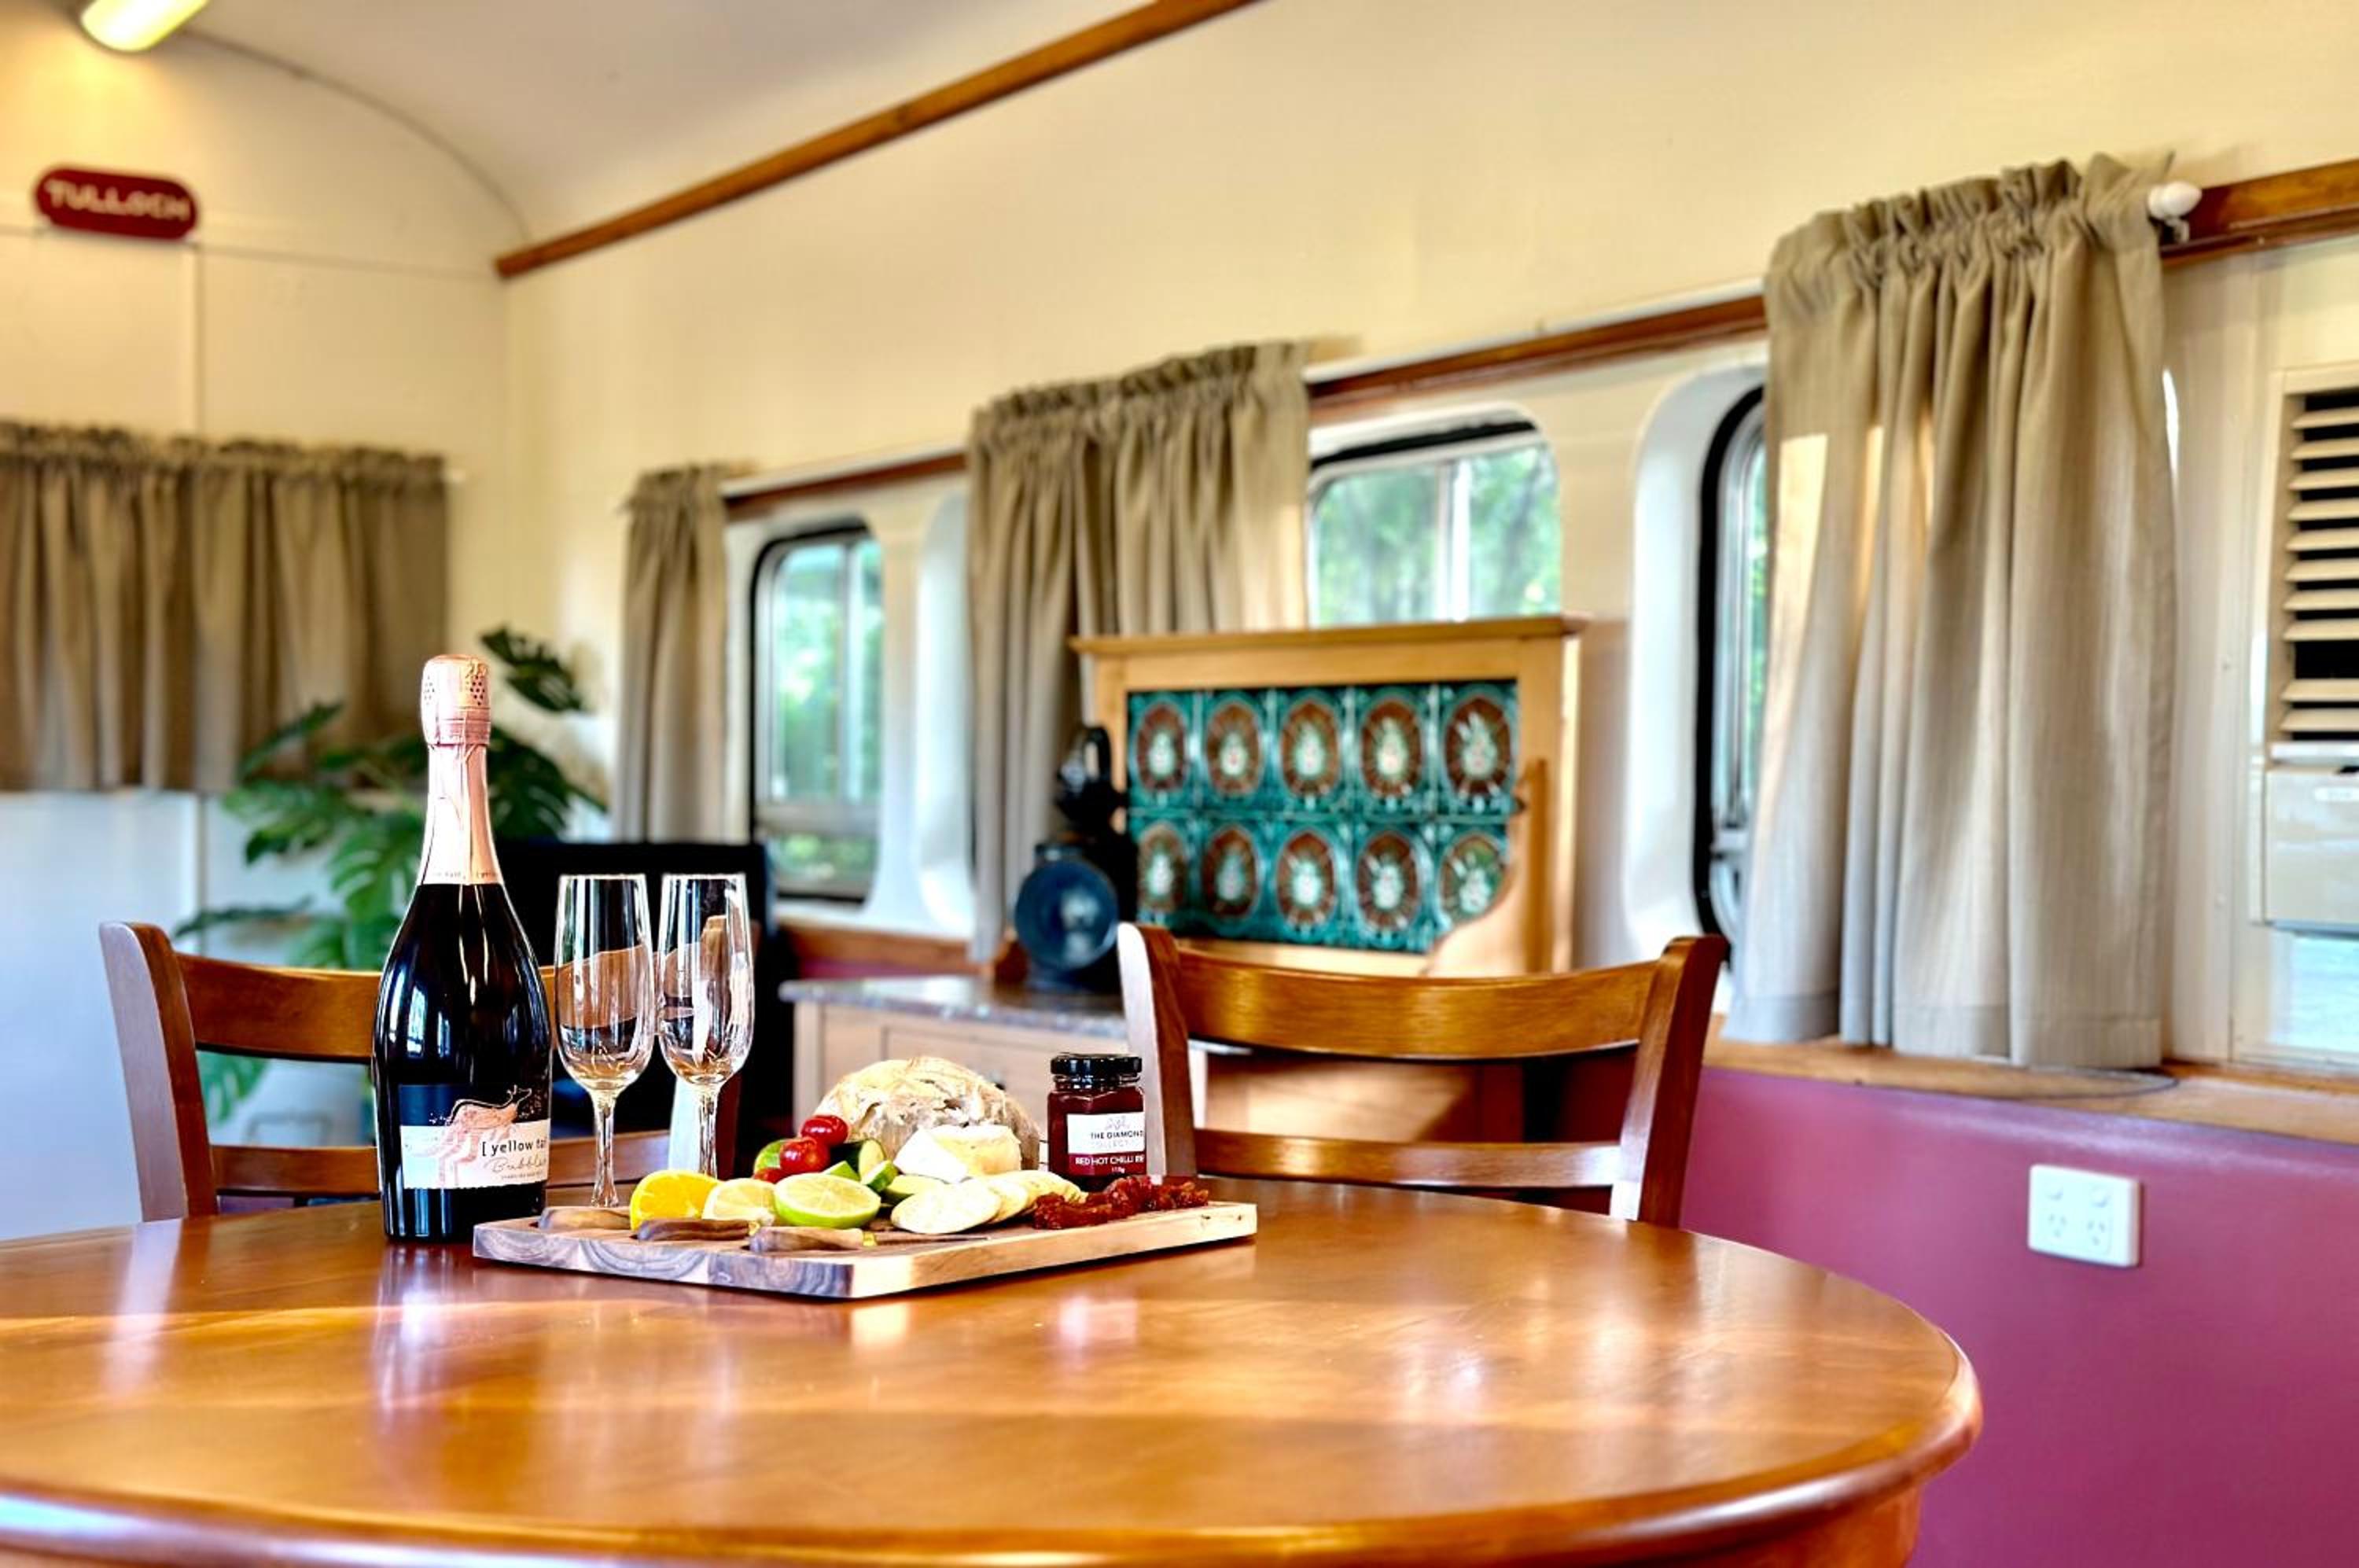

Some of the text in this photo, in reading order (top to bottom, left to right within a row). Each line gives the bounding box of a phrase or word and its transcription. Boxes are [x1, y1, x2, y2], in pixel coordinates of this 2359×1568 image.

[44, 179, 191, 222] TULLOCH
[491, 1140, 533, 1157] yellow
[1075, 1157, 1091, 1165] RED
[1091, 1156, 1108, 1165] HOT
[1110, 1155, 1133, 1164] CHILLI
